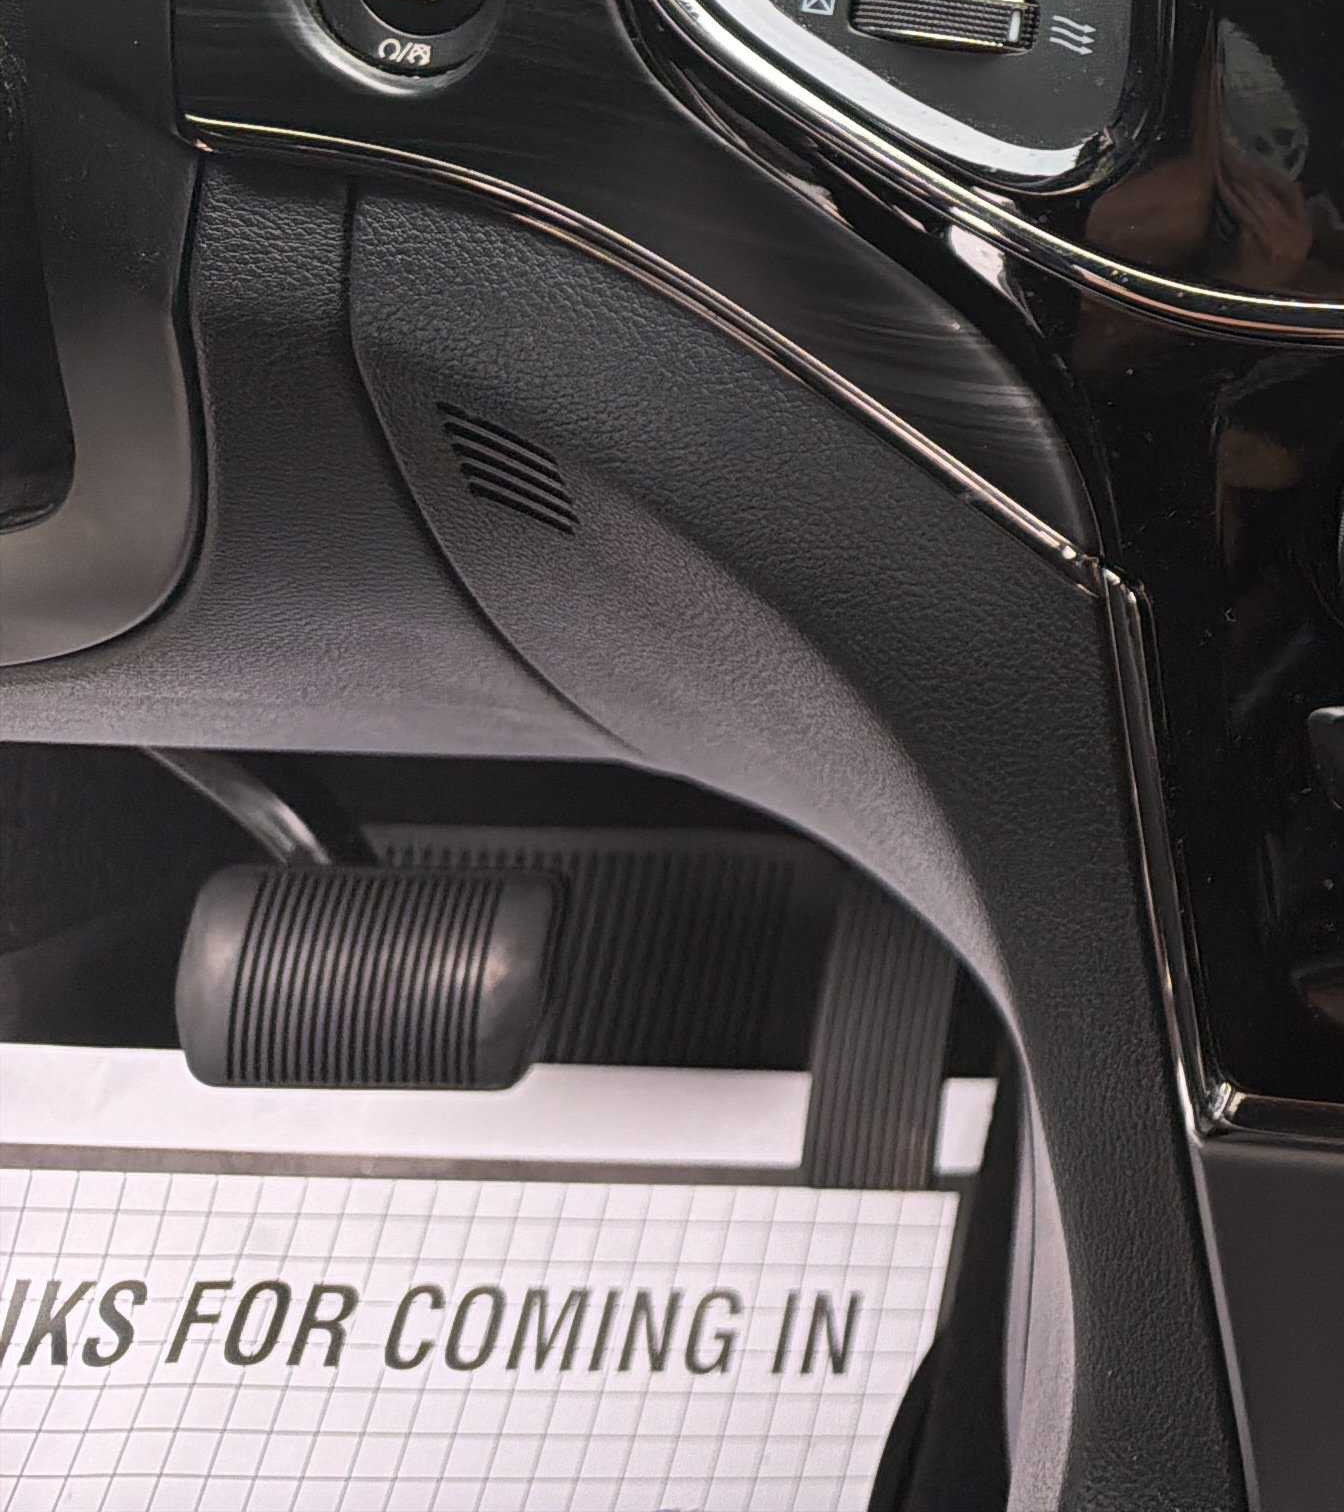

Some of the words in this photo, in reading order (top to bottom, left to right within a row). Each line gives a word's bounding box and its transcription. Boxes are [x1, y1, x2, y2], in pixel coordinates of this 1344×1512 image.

[164, 1278, 360, 1369] FOR
[384, 1284, 743, 1376] COMING
[771, 1292, 861, 1376] IN
